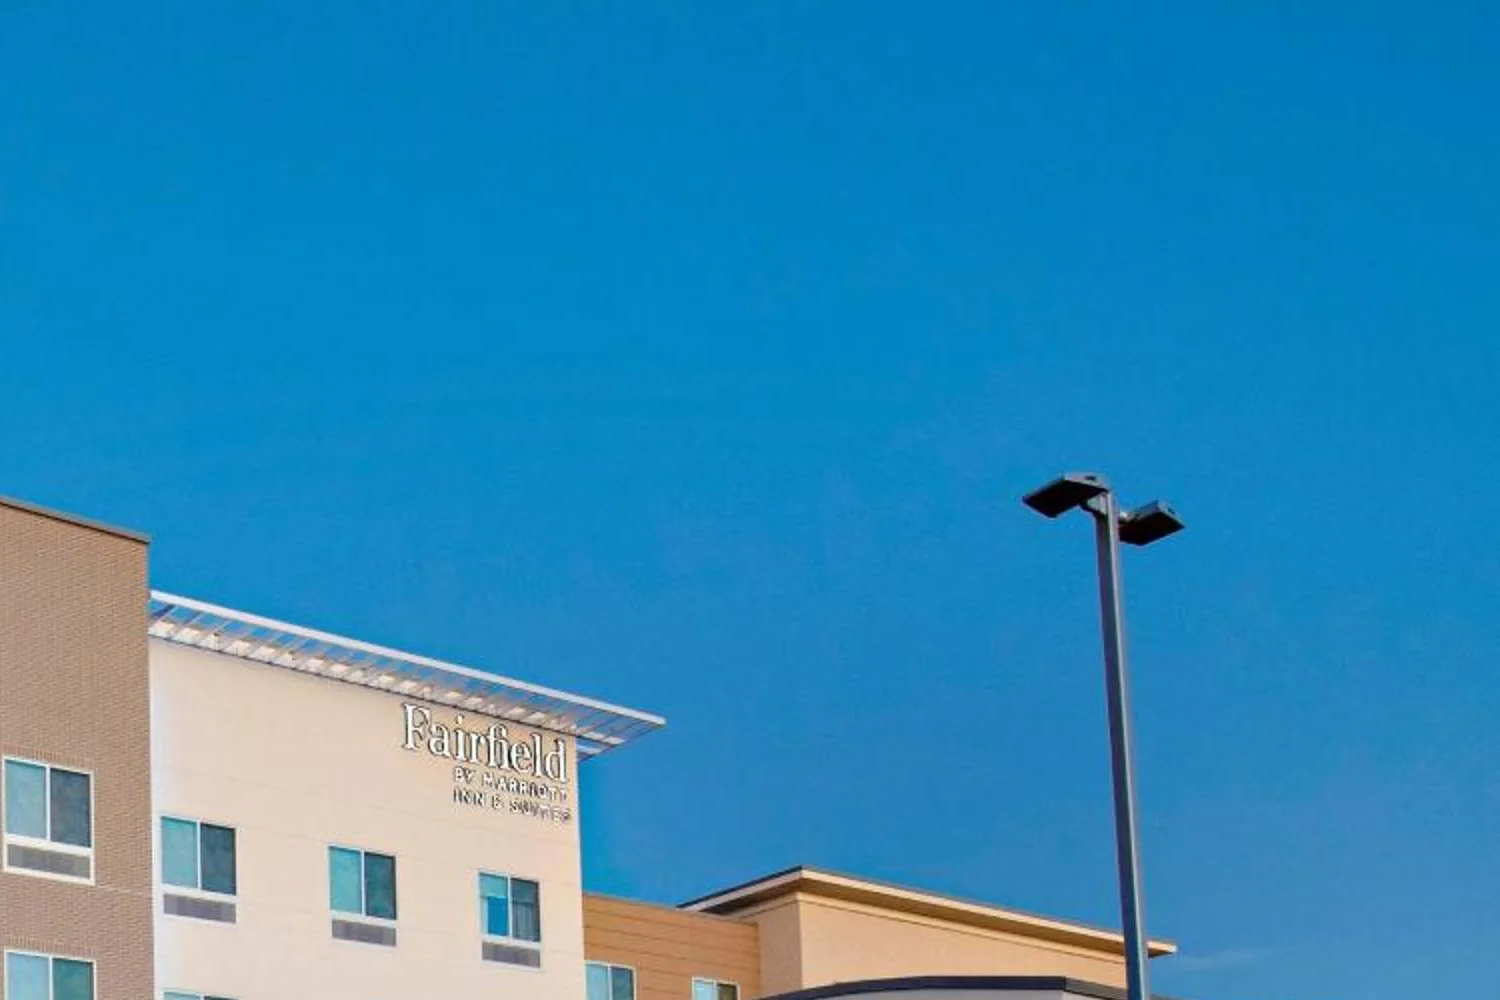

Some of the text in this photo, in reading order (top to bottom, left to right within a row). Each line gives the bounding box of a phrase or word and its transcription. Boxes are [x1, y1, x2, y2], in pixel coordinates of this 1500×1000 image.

[402, 703, 568, 783] Fairfield
[453, 787, 484, 808] INN
[454, 766, 567, 803] BY MARRIOTT
